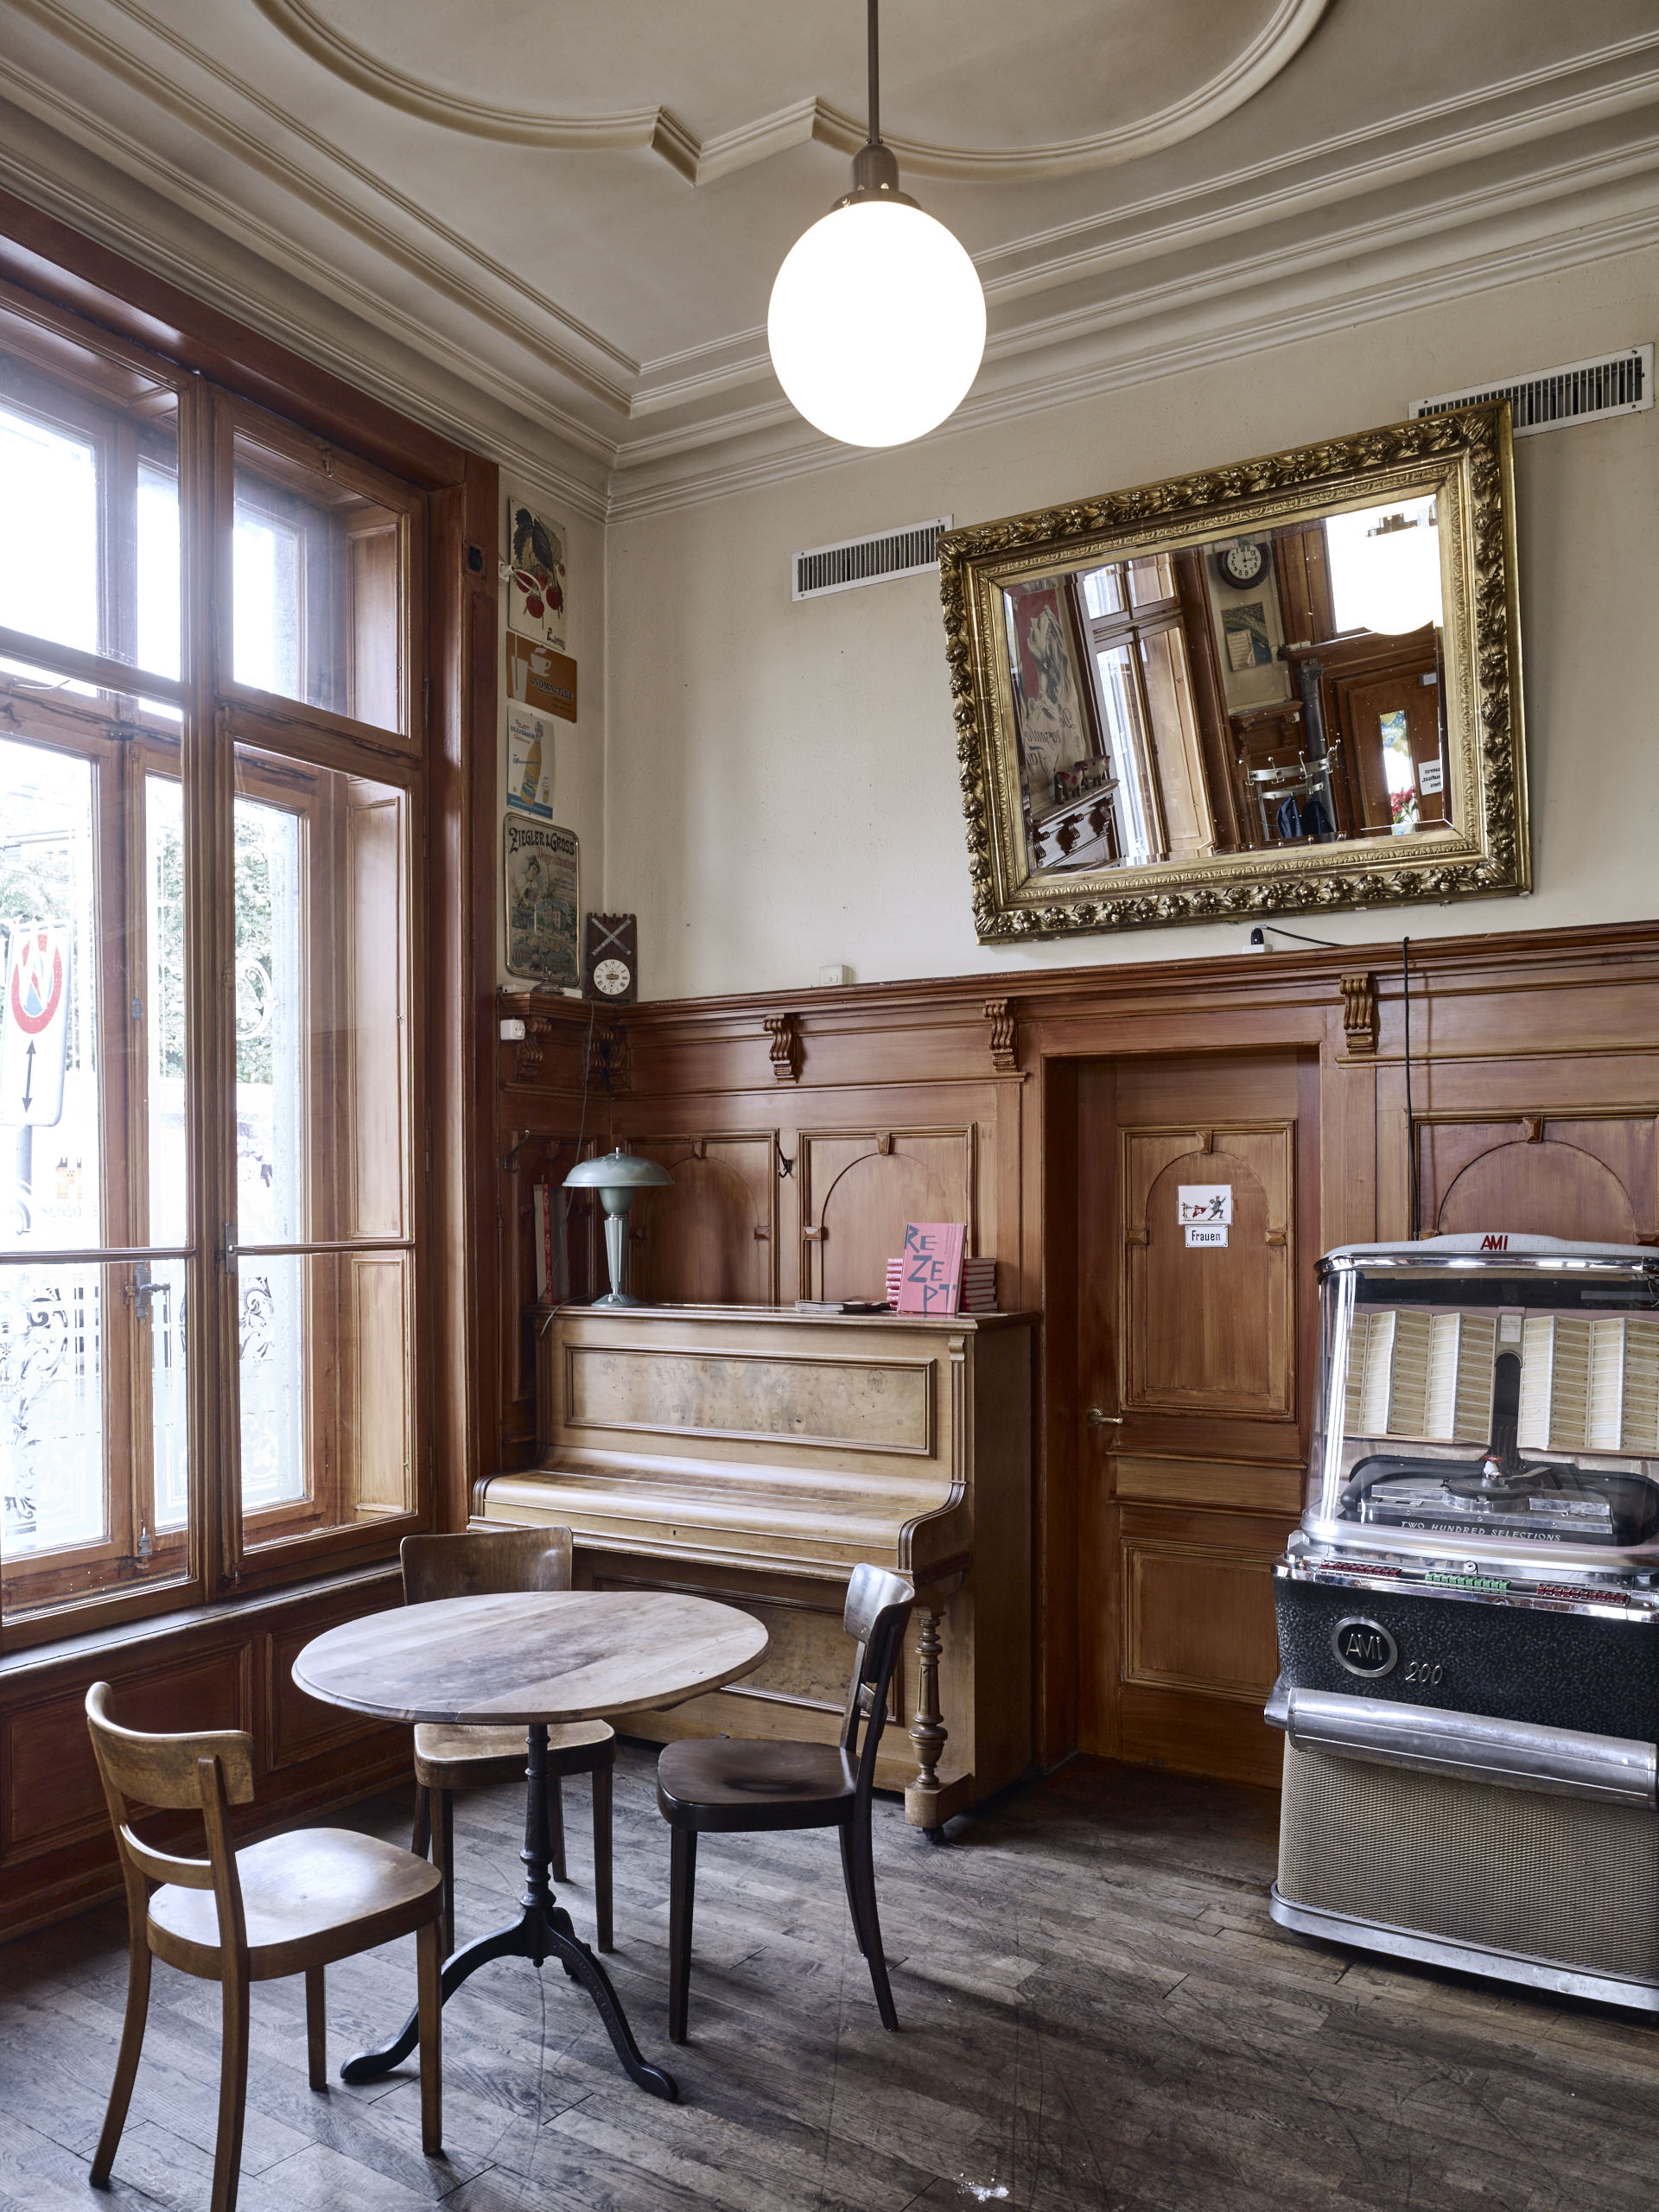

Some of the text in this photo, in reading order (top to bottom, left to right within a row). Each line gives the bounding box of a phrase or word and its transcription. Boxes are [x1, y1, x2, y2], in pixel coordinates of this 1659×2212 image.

[531, 676, 574, 700] OVOMALTINE
[508, 827, 544, 854] ZIEGLER
[550, 833, 575, 855] GROSS
[1192, 1230, 1221, 1242] Frauen
[1479, 1235, 1509, 1251] AMI
[1401, 1521, 1561, 1542] TWO HUNDRED SELECTIONS
[1345, 1632, 1382, 1661] AMI
[1404, 1662, 1444, 1685] 200
